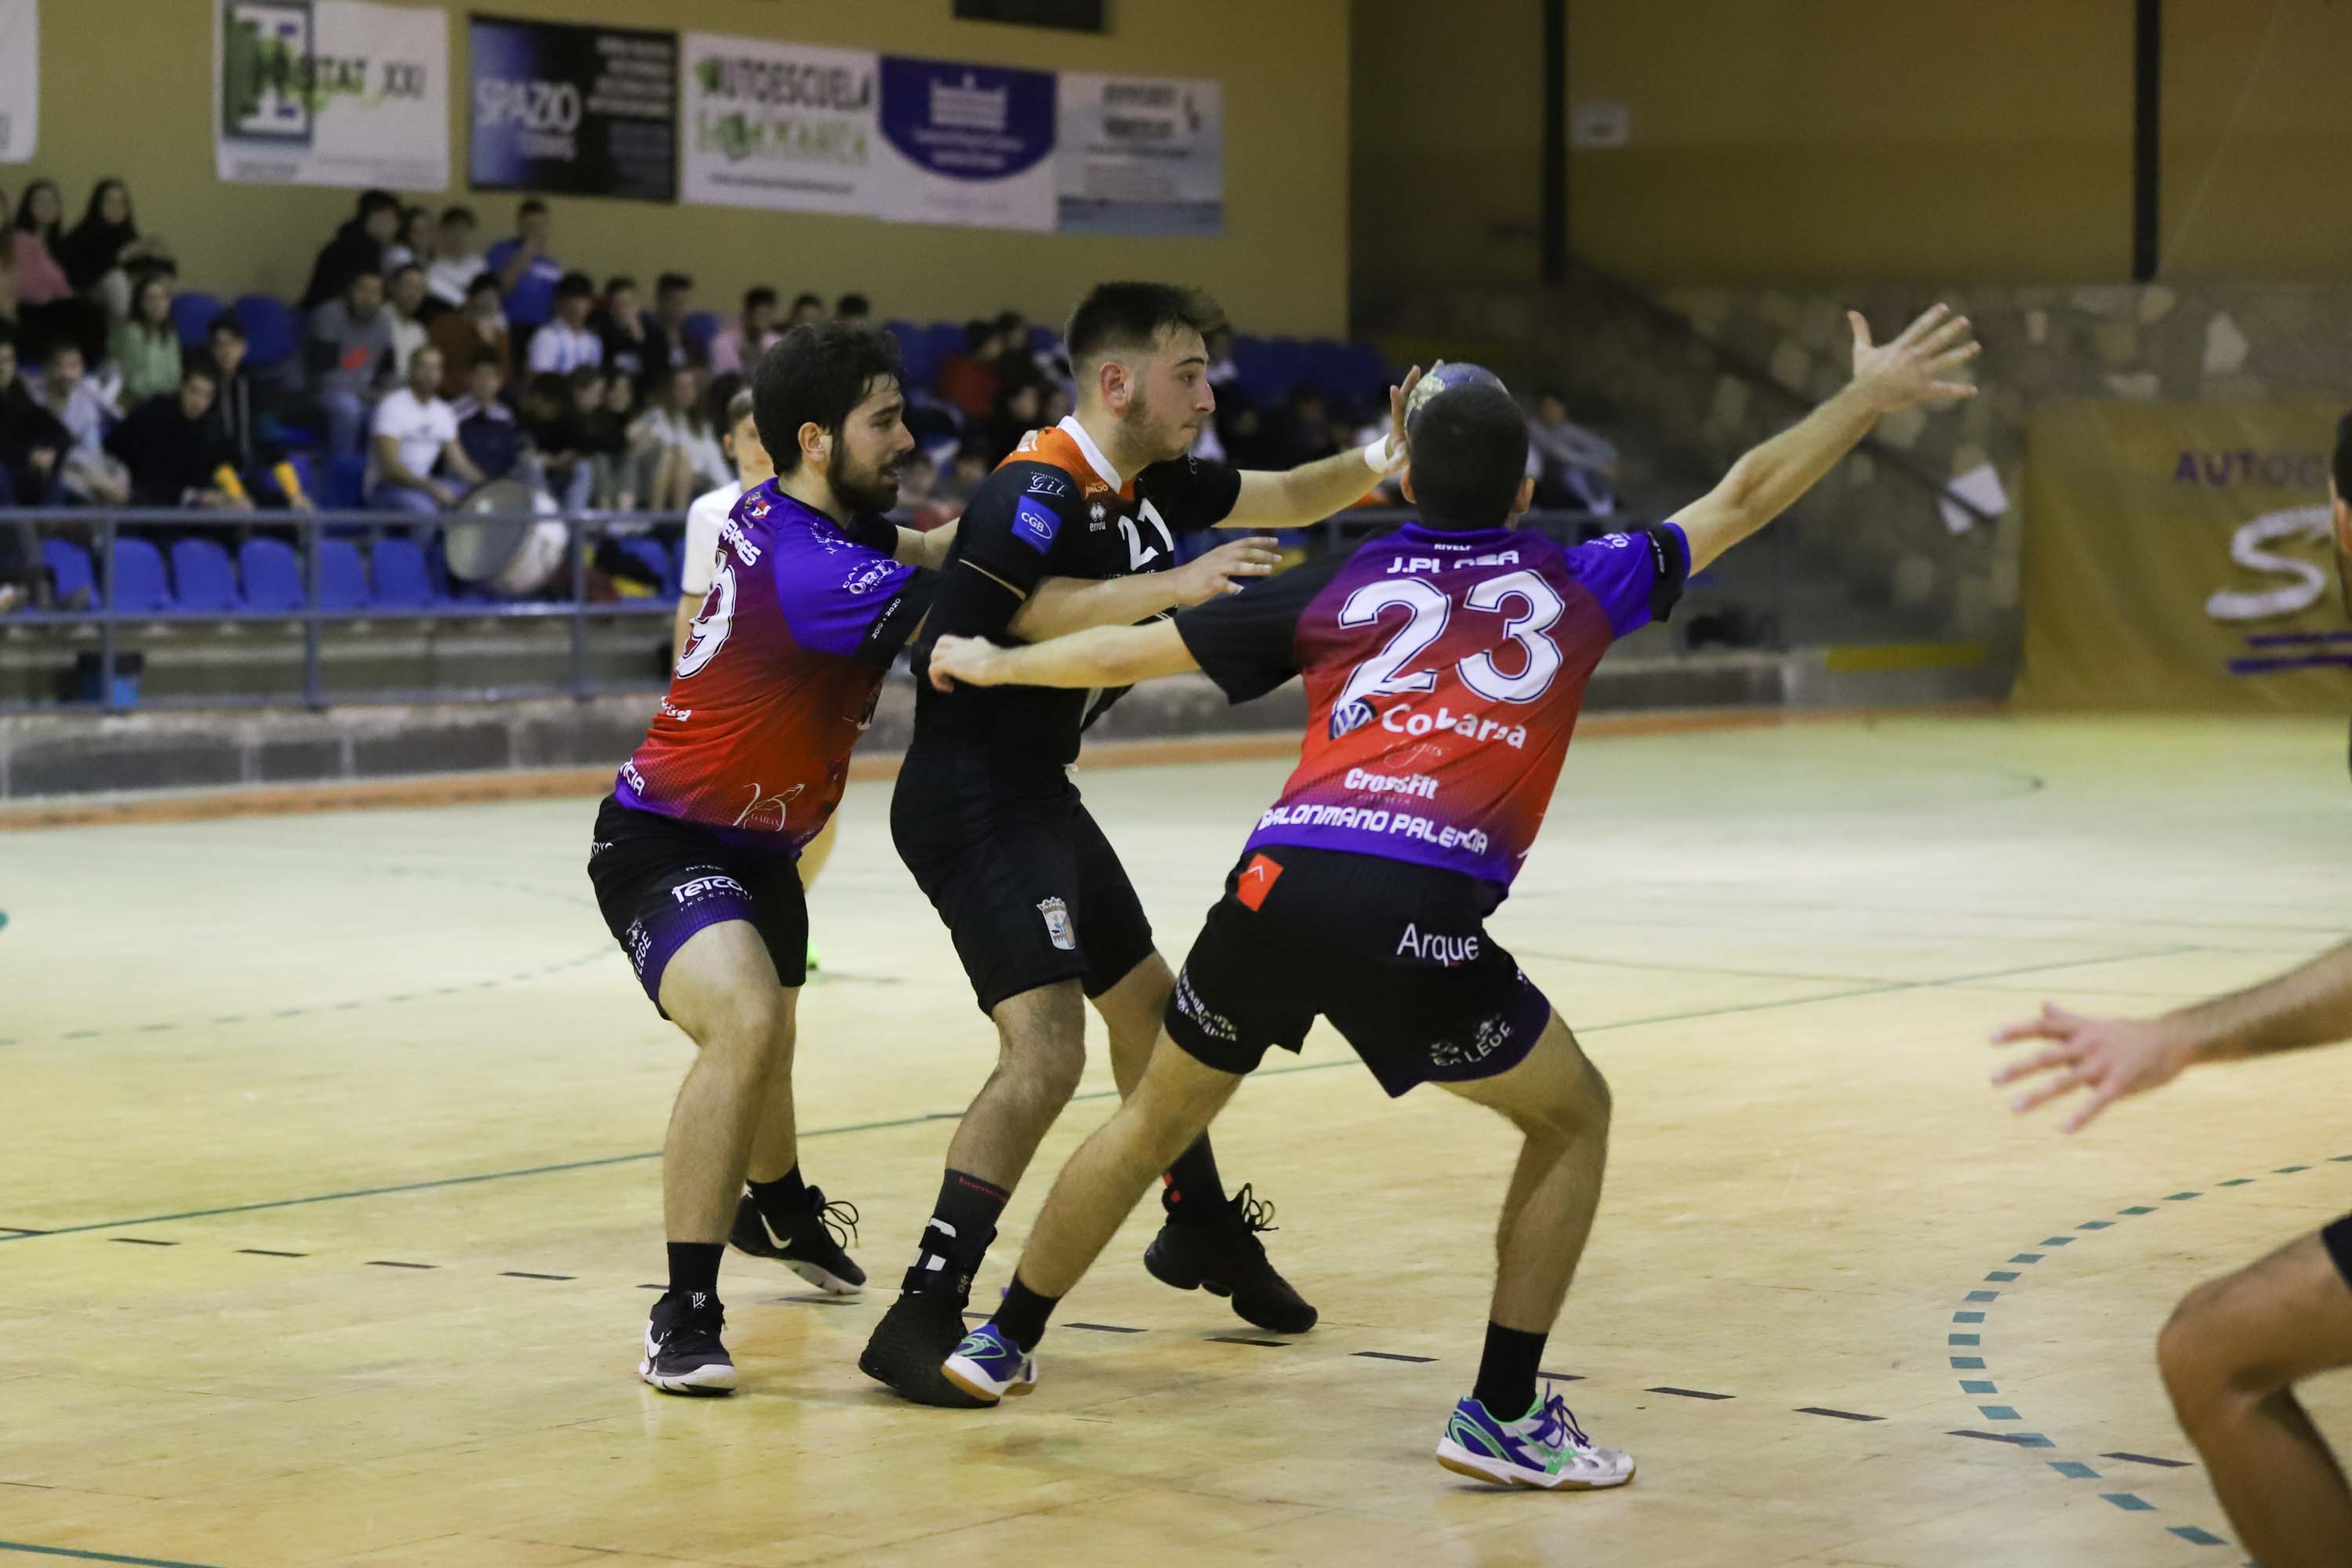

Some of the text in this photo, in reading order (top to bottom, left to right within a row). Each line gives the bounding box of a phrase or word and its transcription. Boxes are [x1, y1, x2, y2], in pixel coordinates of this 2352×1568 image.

[1022, 512, 1044, 532] CGB
[1117, 497, 1175, 572] 21
[885, 597, 902, 617] 2020
[1338, 569, 1566, 705] 23
[1381, 703, 1527, 750] Cobarsa
[1344, 768, 1439, 800] CrossFit
[1257, 804, 1488, 855] BALONMANO PALENCIA
[1396, 923, 1479, 967] Arque
